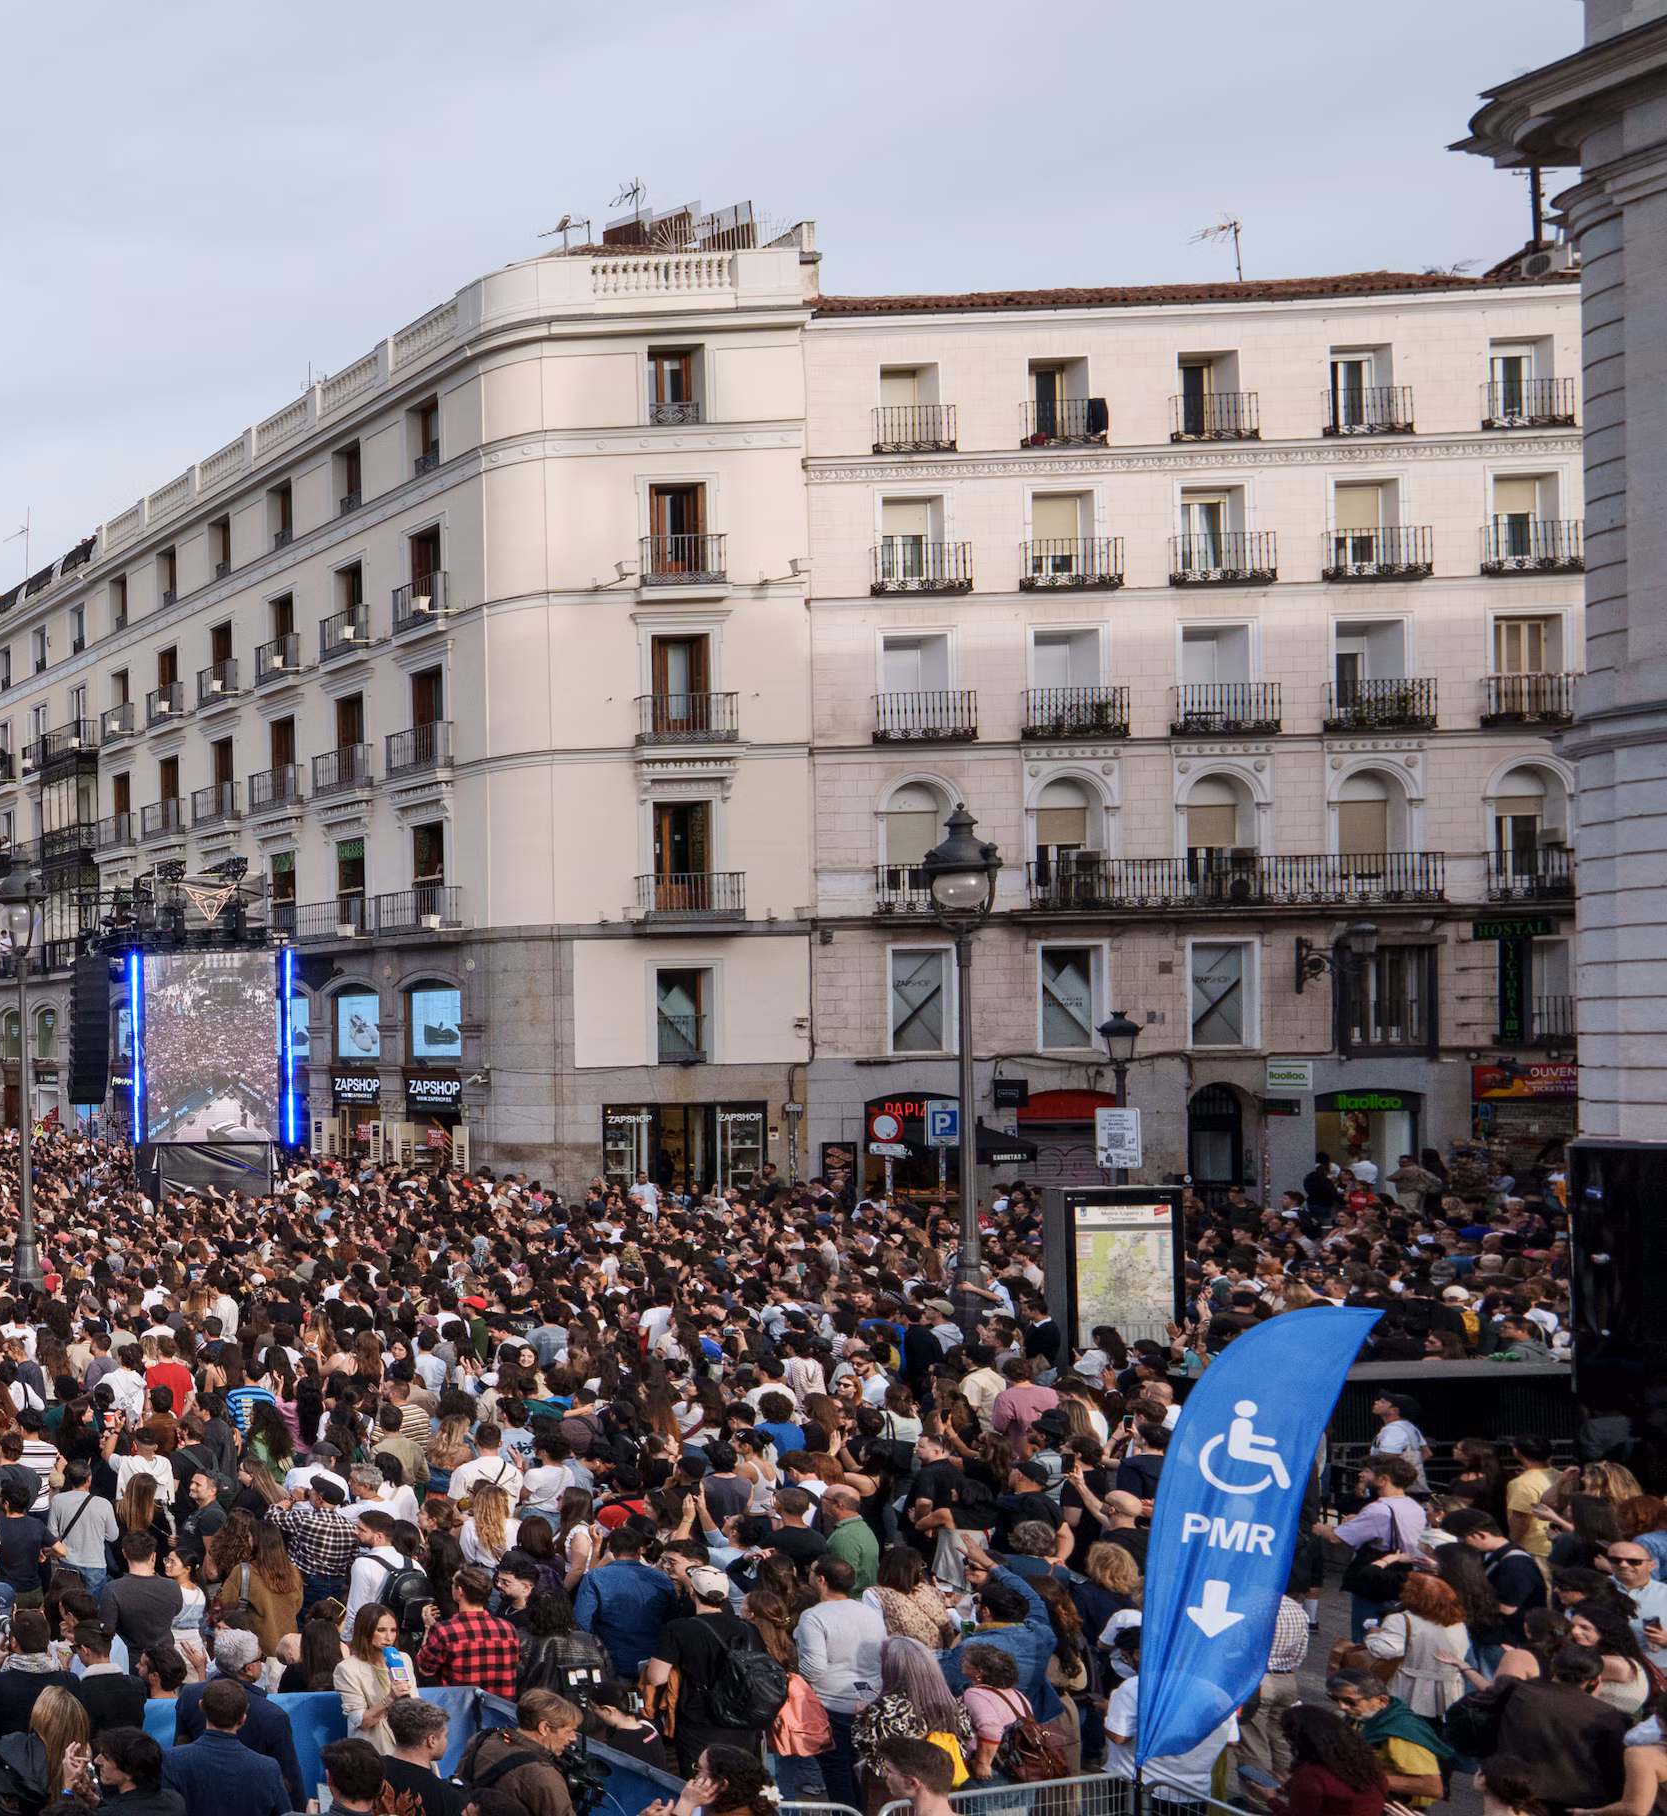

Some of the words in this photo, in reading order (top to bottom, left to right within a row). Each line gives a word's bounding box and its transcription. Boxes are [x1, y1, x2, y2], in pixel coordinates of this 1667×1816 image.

[1478, 921, 1547, 937] HOSTAL
[1506, 941, 1518, 1018] VICTORIA
[1269, 1071, 1308, 1081] llaollao.
[1530, 1067, 1577, 1077] OUVEN
[334, 1077, 380, 1093] ZAPSHOP
[409, 1079, 460, 1096] ZAPSHOP
[608, 1115, 652, 1124] ZAPSHOP
[718, 1113, 763, 1122] ZAPSHOP
[935, 1113, 952, 1135] P
[1180, 1512, 1276, 1556] PMR
